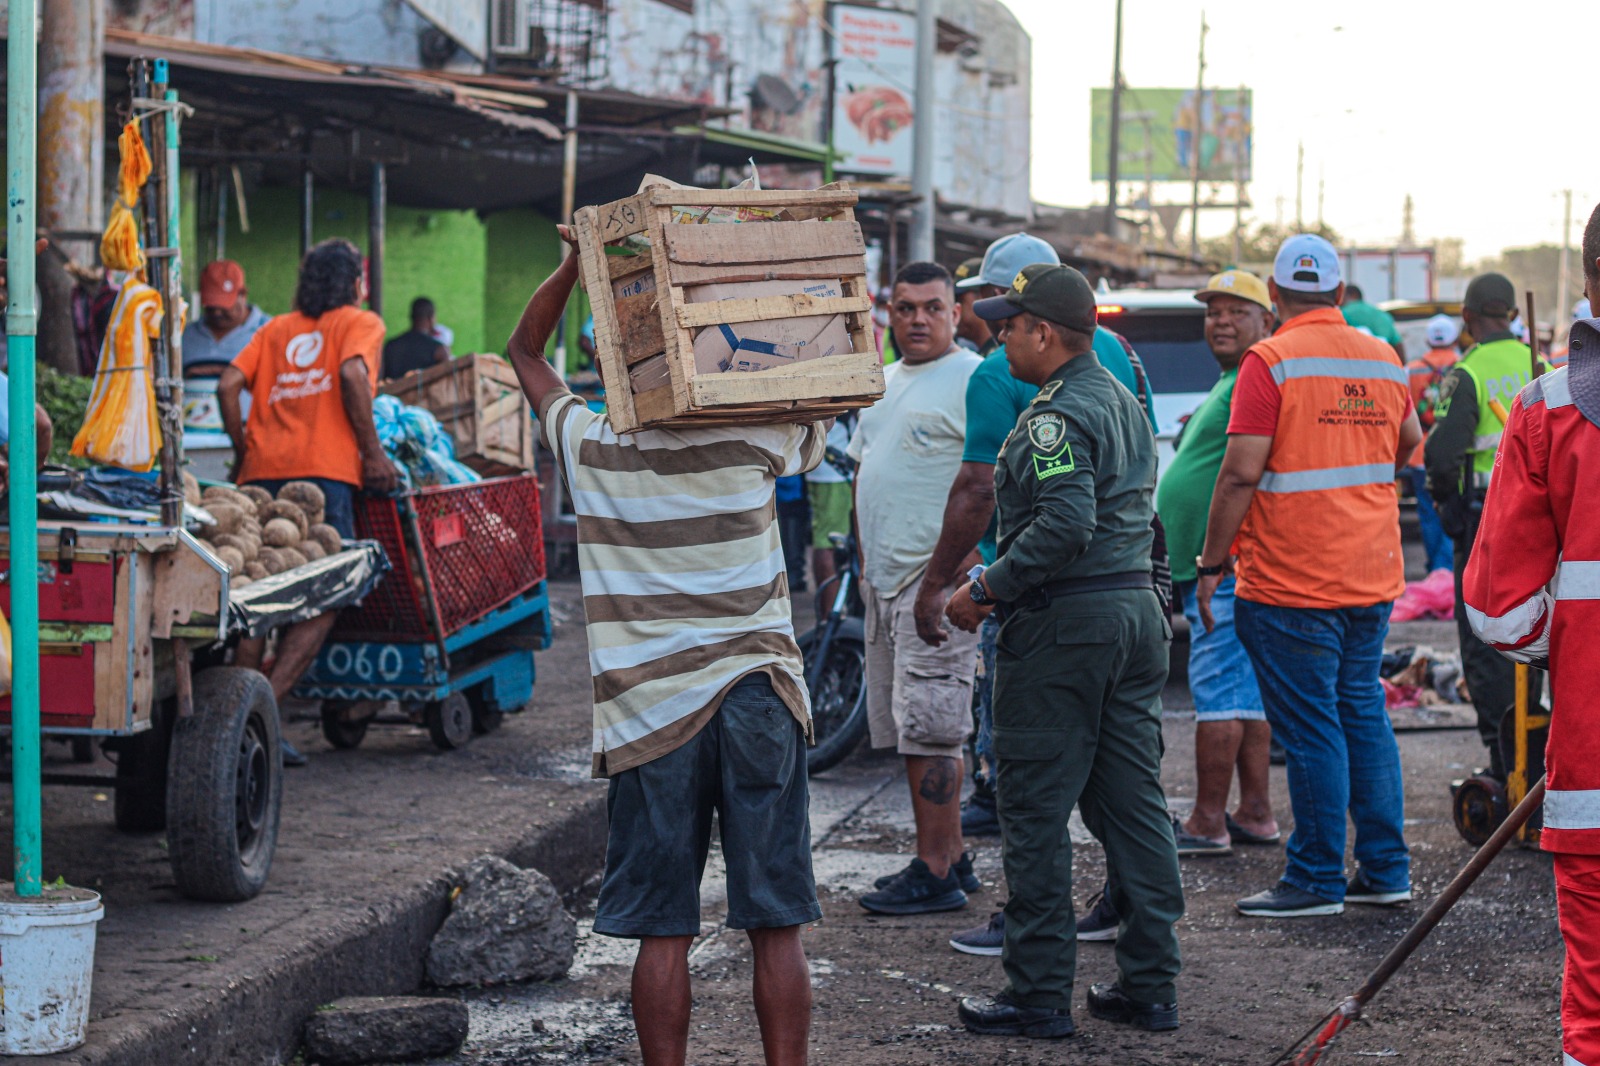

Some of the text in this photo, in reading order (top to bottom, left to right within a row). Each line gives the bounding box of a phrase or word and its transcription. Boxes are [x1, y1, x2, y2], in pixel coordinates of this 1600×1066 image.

[1343, 383, 1367, 398] 063
[1338, 398, 1375, 410] GEPM
[327, 642, 403, 682] 060
